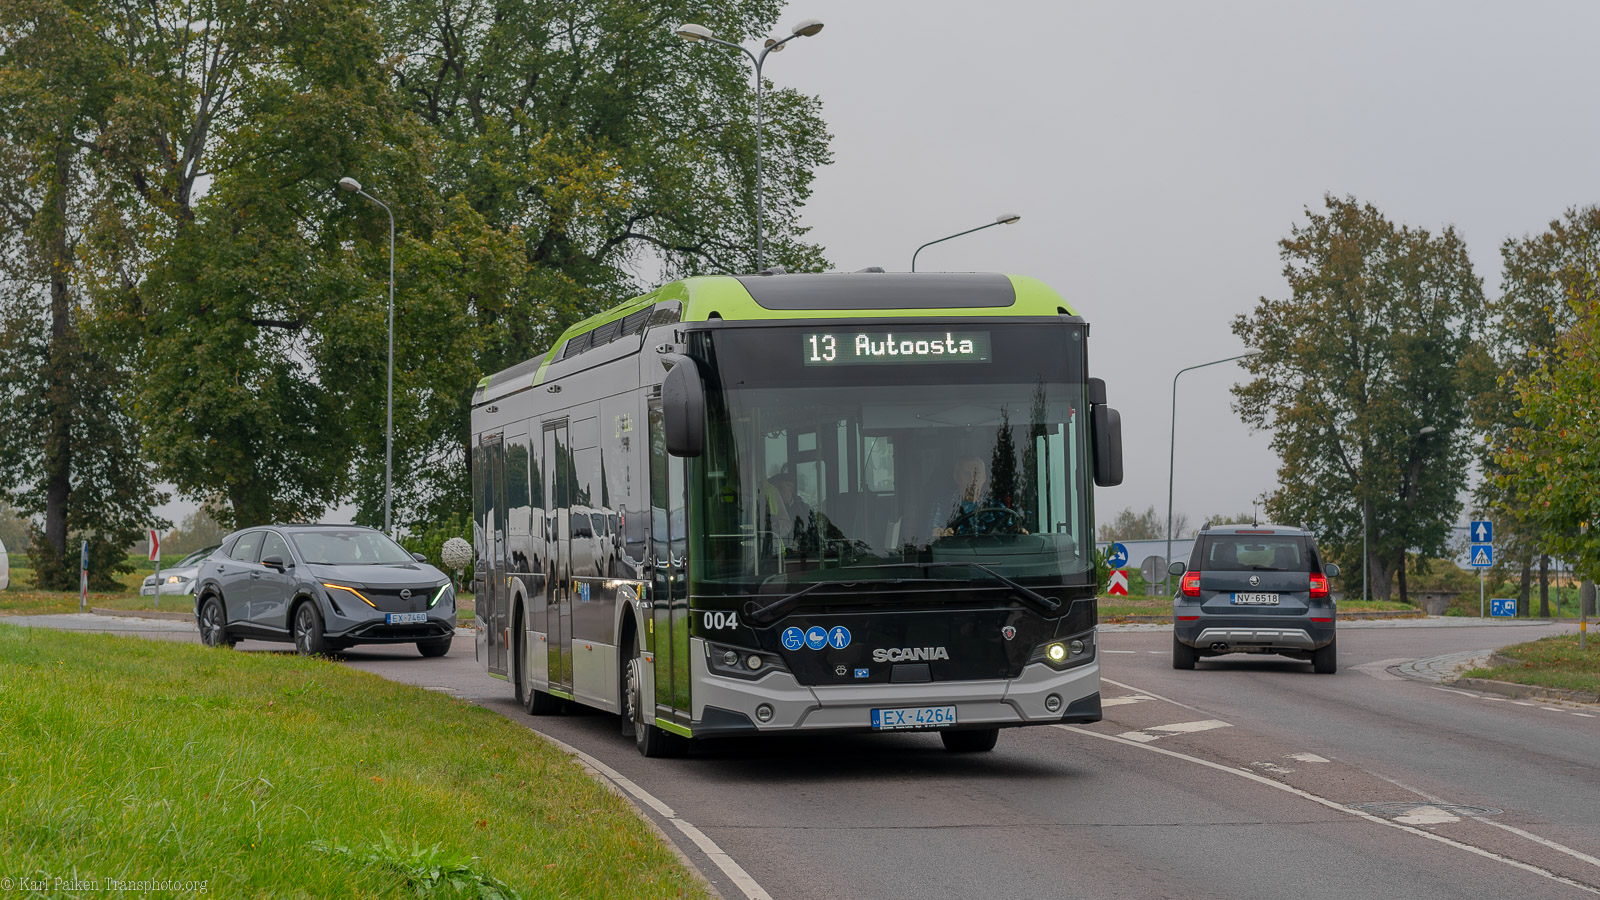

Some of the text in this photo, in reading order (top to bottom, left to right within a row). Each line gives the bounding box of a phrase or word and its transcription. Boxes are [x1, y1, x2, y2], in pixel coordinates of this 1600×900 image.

[809, 332, 974, 362] 13 Autoosta
[1237, 594, 1278, 603] NV-6518
[392, 613, 425, 622] EX-7460
[703, 611, 738, 630] 004
[872, 646, 950, 662] SCANIA
[883, 708, 954, 725] EX-4264
